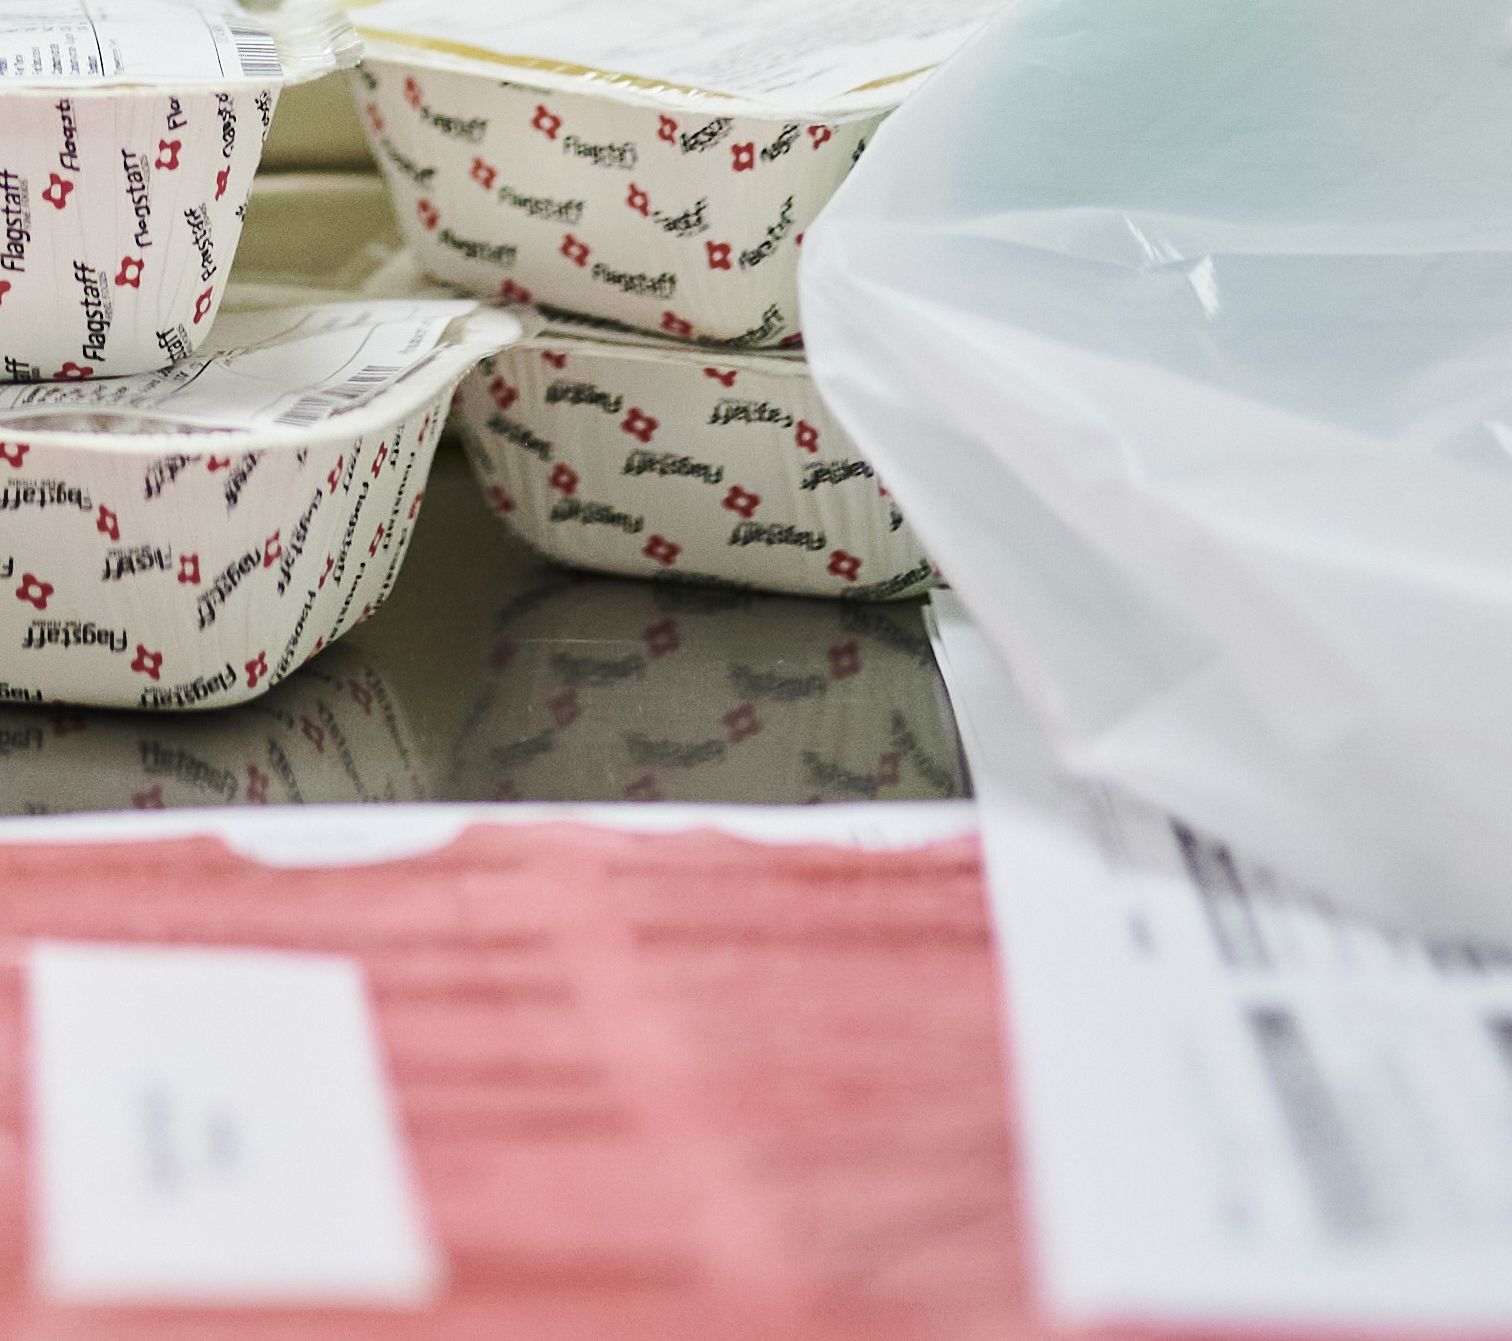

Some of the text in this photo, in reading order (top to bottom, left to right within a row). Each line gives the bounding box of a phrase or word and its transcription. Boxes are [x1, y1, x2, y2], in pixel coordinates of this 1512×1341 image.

[55, 99, 80, 172] Flagst
[73, 261, 110, 361] Flagstaff
[22, 621, 128, 652] Flagstaff
